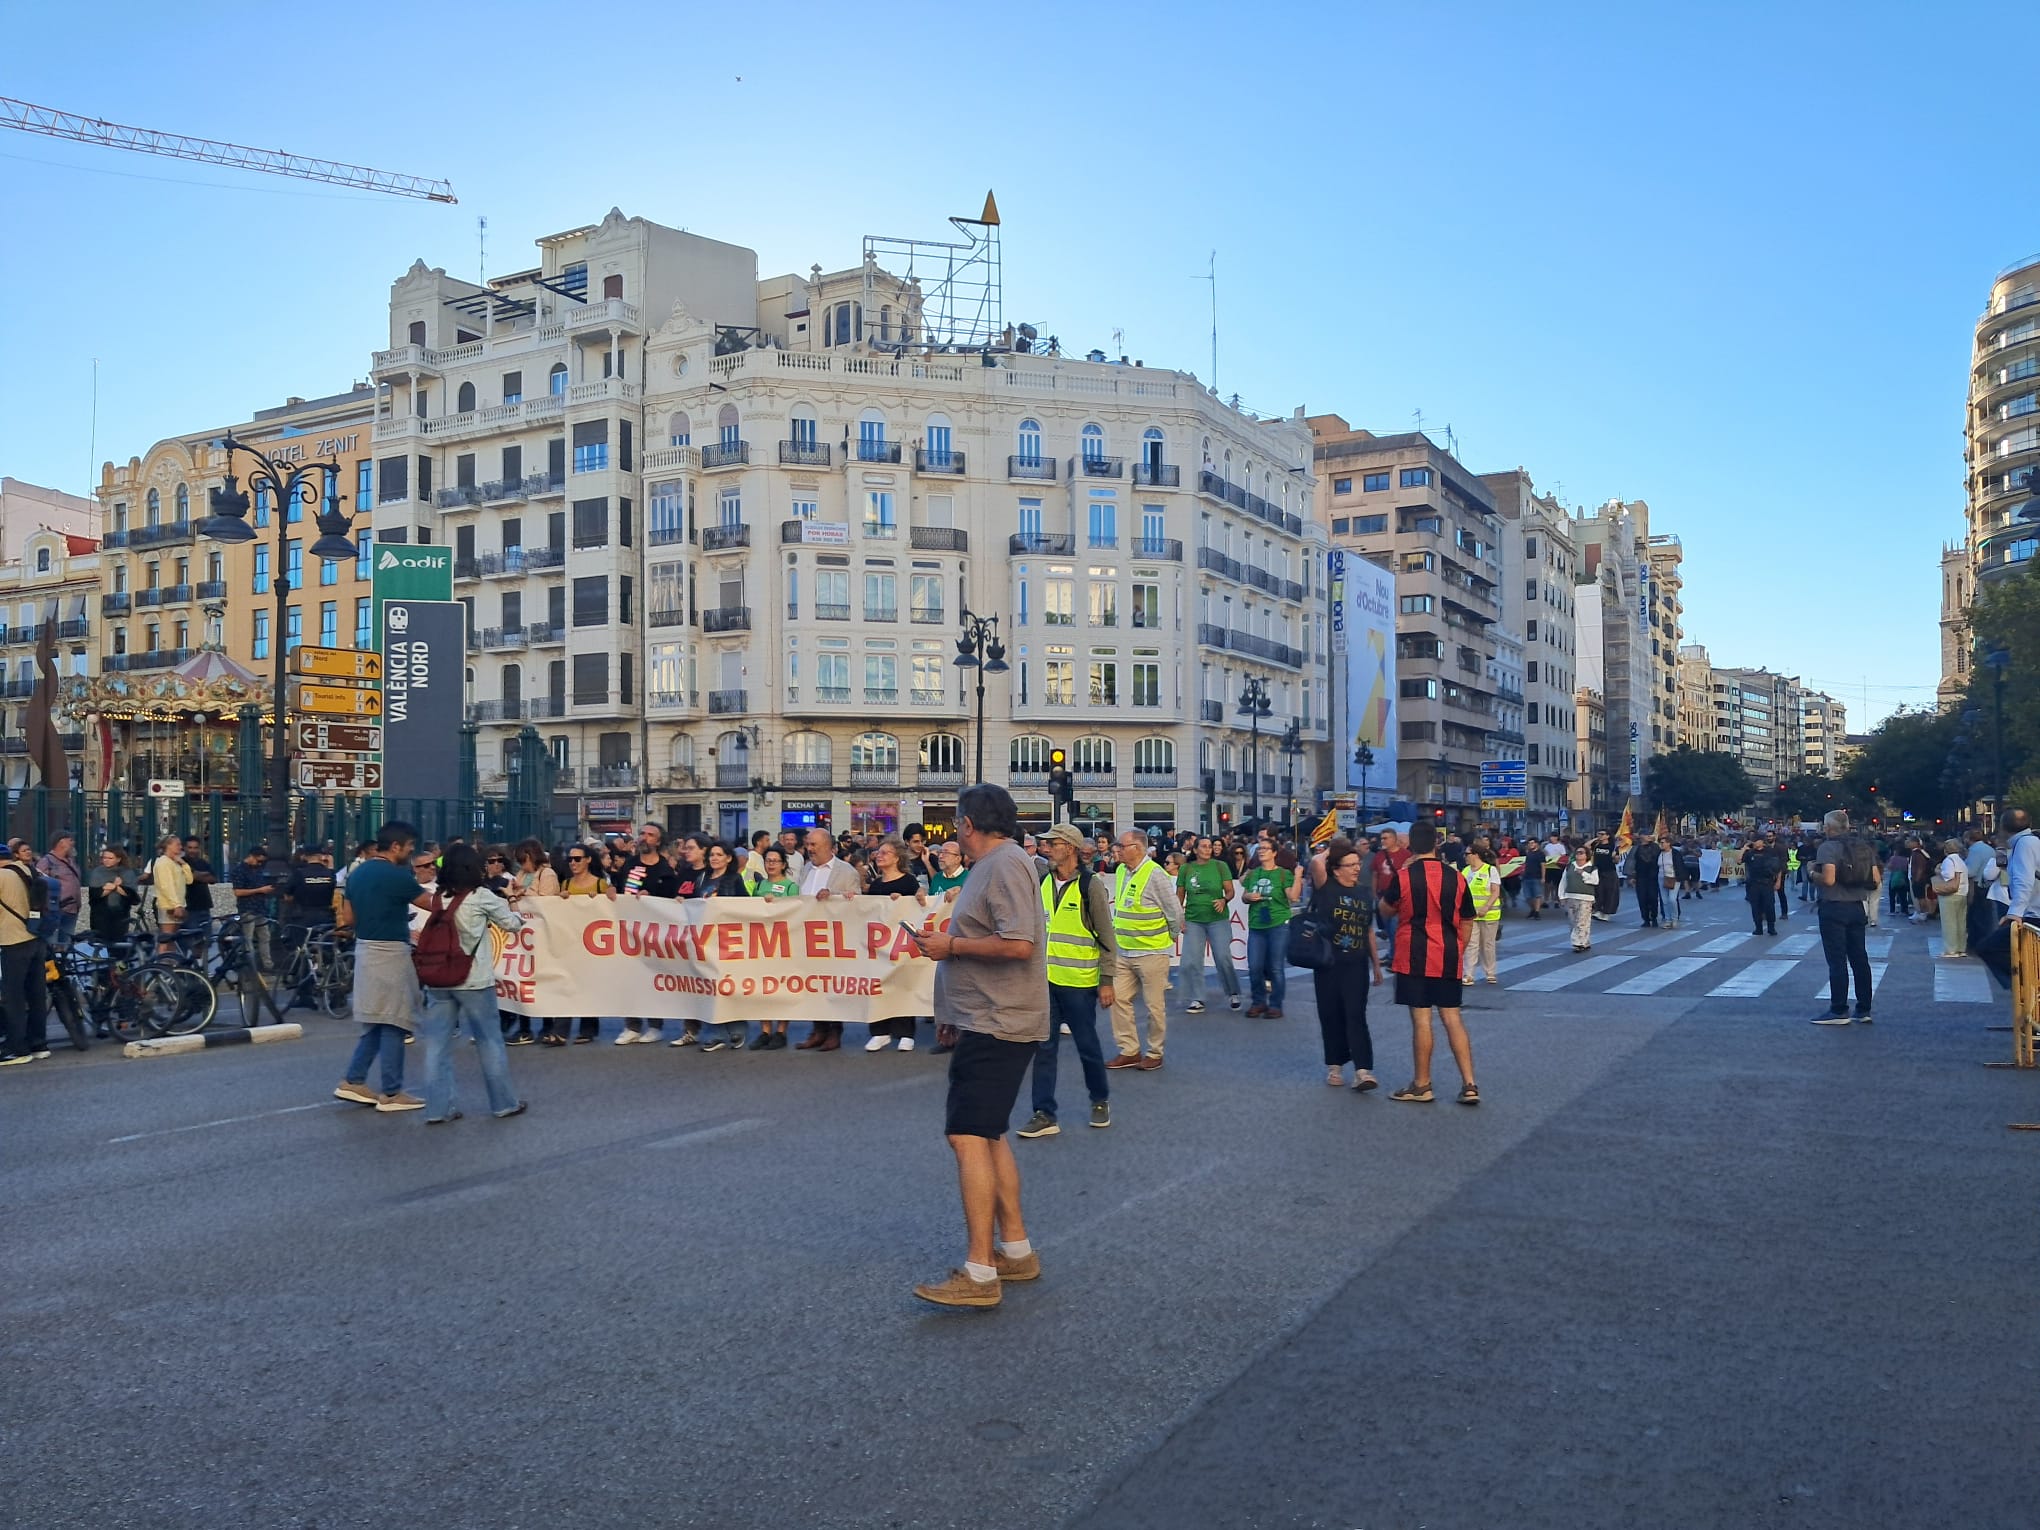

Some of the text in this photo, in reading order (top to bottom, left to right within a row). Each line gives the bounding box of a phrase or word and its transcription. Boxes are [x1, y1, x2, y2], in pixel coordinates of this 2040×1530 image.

[315, 433, 359, 457] ZENIT
[402, 556, 447, 569] adif
[1375, 578, 1389, 600] Nou
[411, 641, 429, 688] NORD
[386, 641, 408, 723] VALÈNCIA
[582, 919, 792, 962] GUANYEM
[804, 920, 857, 959] EL
[1340, 923, 1363, 936] AND
[502, 953, 536, 978] TU
[654, 973, 883, 997] COMISSIÓ 9 D'OCTUBRE
